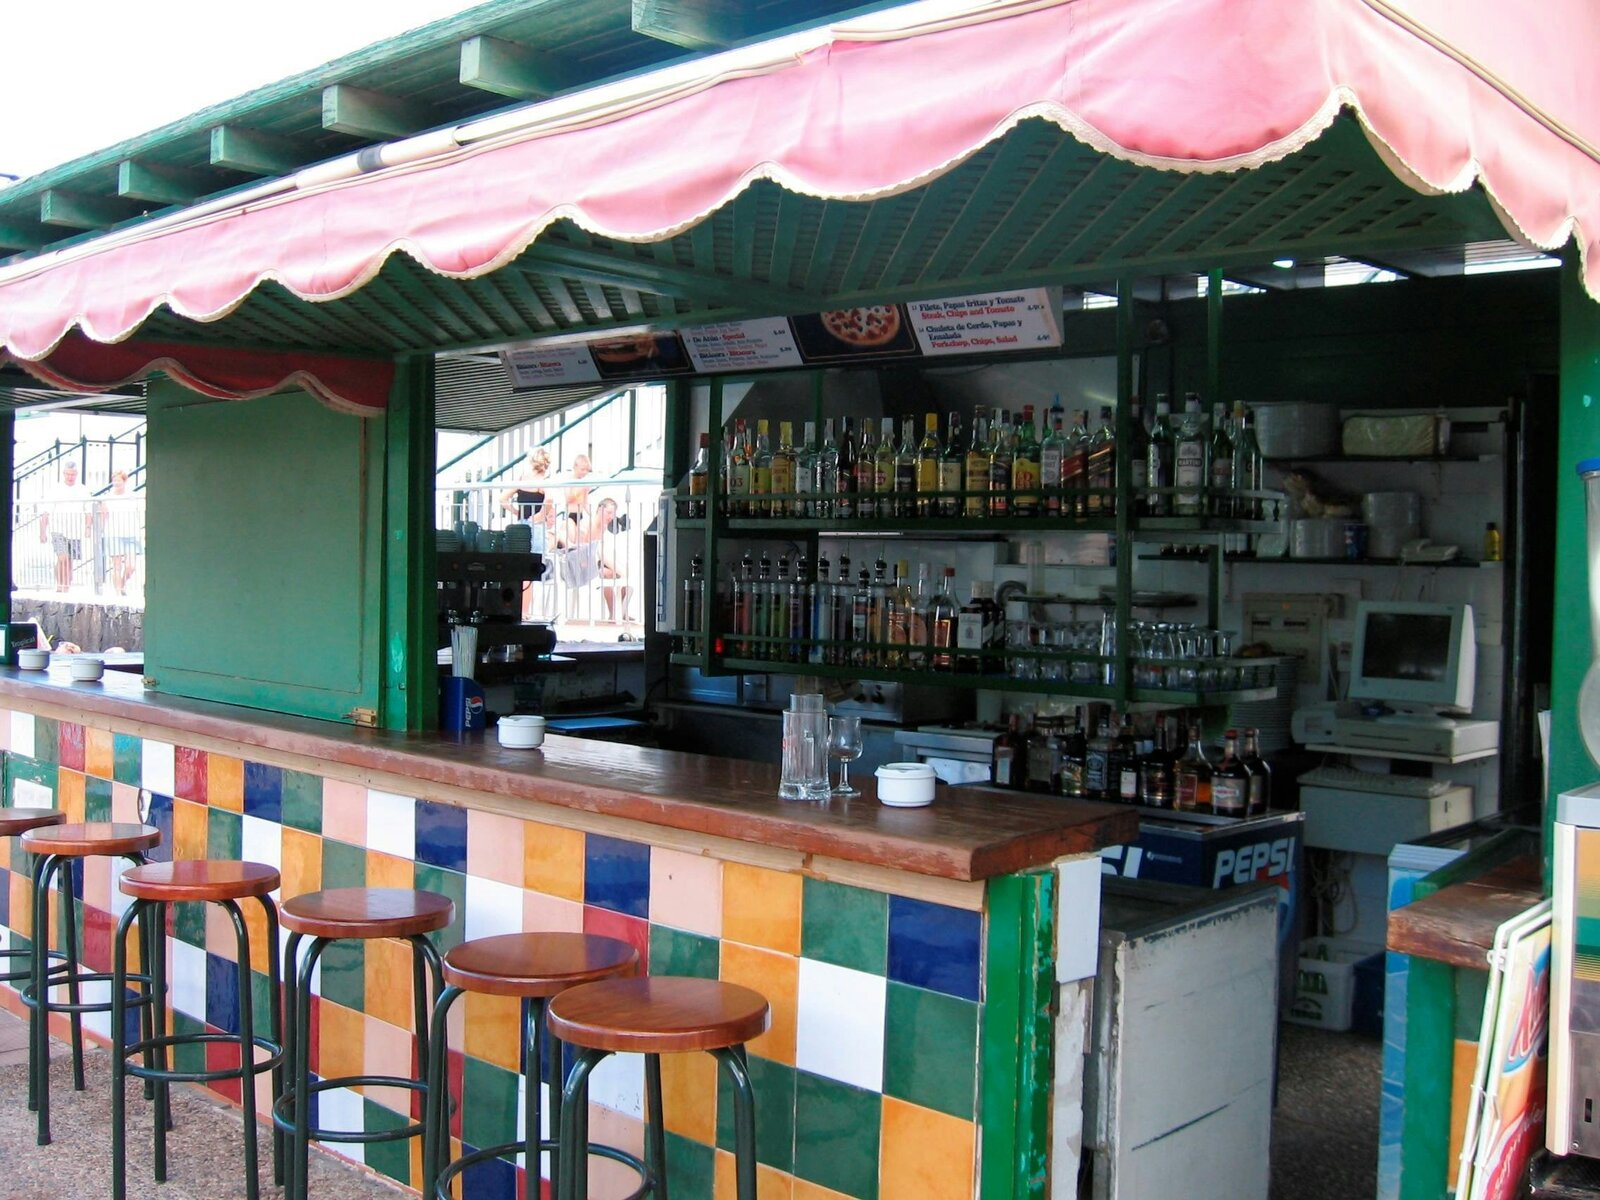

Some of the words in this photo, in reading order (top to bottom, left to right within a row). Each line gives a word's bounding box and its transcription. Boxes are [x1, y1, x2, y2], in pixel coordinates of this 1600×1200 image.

[944, 301, 965, 311] Papas
[989, 299, 994, 307] y
[995, 295, 1025, 305] Tomate
[946, 308, 968, 319] Chips
[969, 308, 984, 316] and
[985, 305, 1015, 314] Tomato
[926, 324, 955, 333] Chuleta
[956, 323, 966, 331] de
[993, 319, 1016, 329] Papas
[1017, 319, 1022, 327] y
[995, 335, 1018, 343] Salad
[1212, 836, 1296, 890] PEPSI
